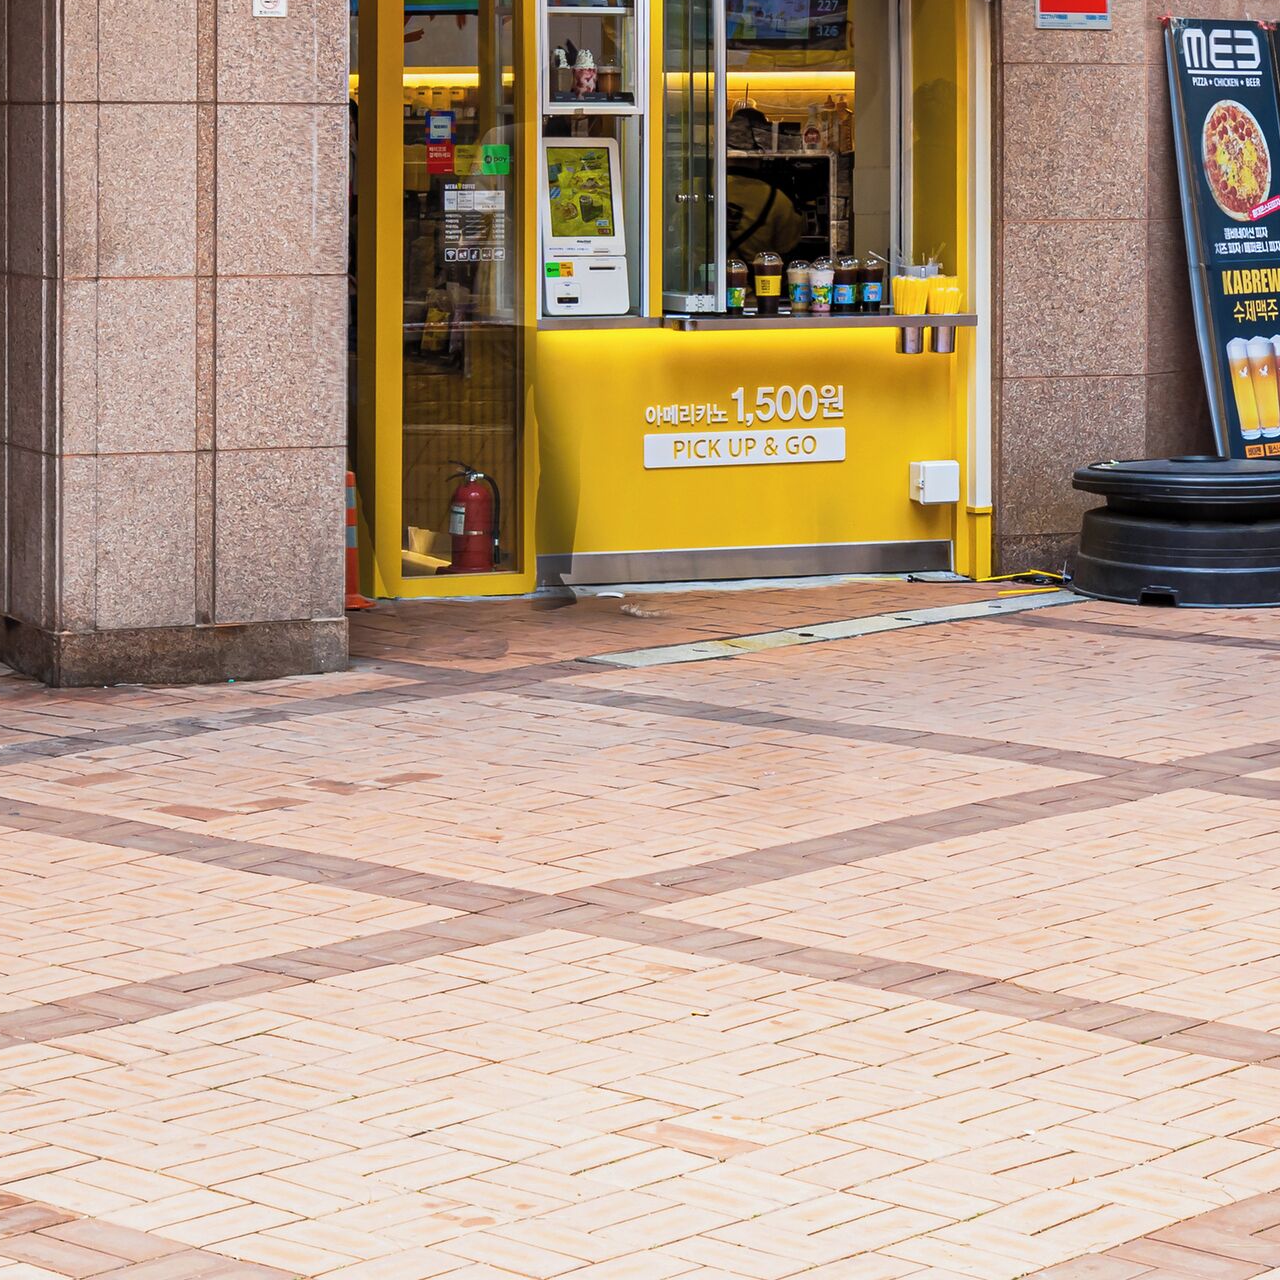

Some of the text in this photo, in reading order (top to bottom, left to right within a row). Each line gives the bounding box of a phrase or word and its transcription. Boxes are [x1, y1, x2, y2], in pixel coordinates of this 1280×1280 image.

[817, 0, 839, 12] 227
[1181, 28, 1261, 69] ME3
[1192, 77, 1261, 87] PIZZA CHICKEN BEER
[1214, 243, 1228, 255] 치즈
[1233, 299, 1279, 323] 수제맥주
[645, 384, 845, 427] 아메리카노 1,500원
[673, 434, 817, 459] PICK UP & GO
